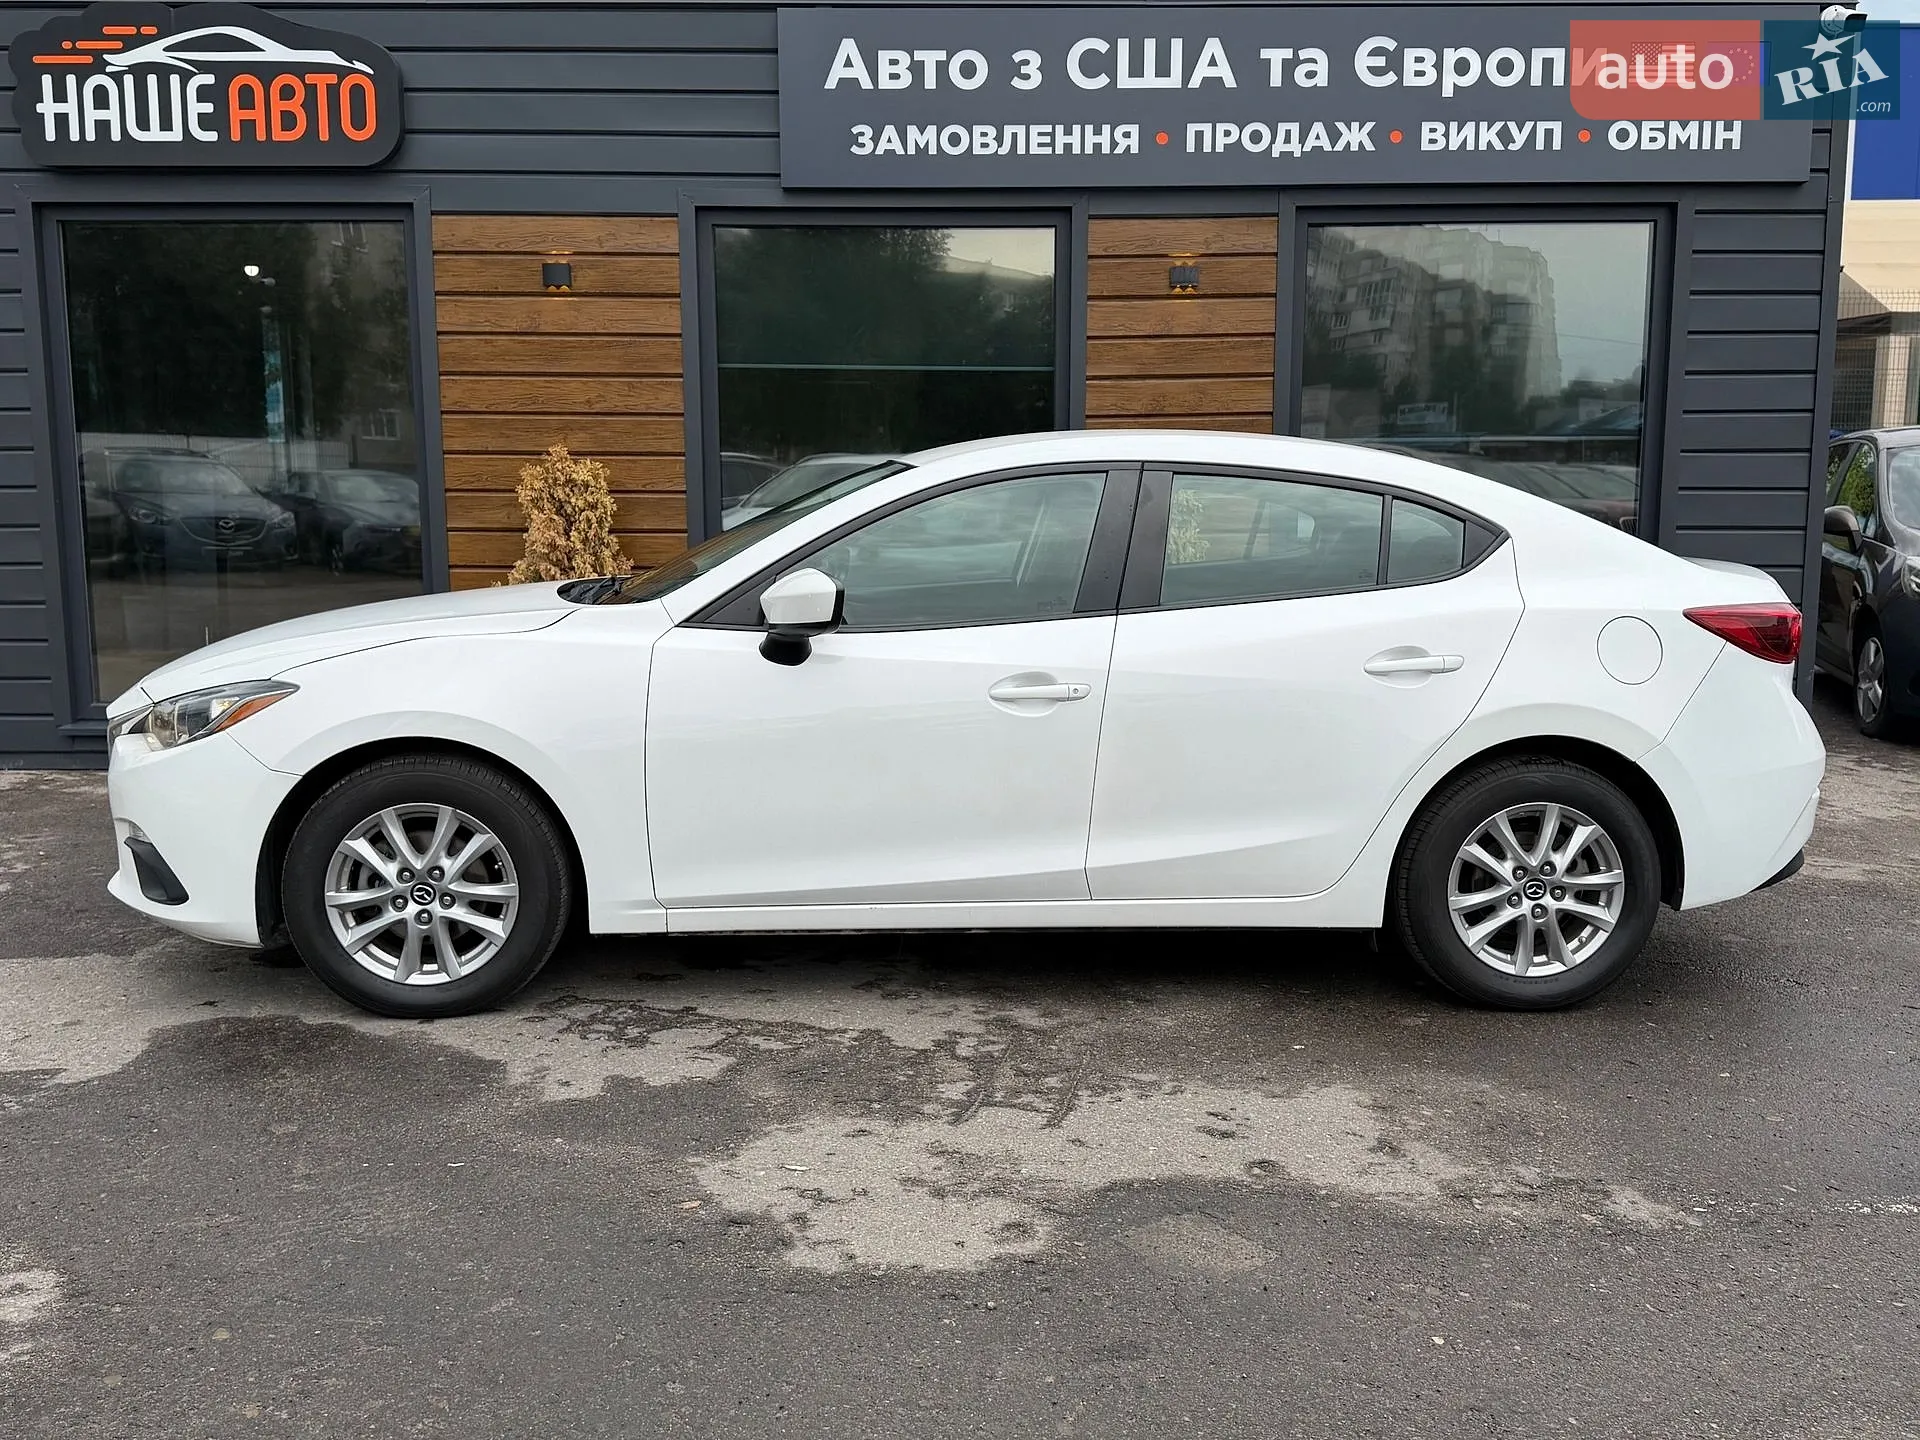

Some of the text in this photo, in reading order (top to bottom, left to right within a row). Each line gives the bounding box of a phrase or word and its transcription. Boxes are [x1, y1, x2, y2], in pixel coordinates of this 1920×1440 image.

[823, 35, 1608, 98] Авто з США та Європи
[35, 73, 377, 142] НАШЕ АВТО
[849, 119, 1742, 158] ЗАМОВЛЕННЯ ПРОДАЖ ВИКУП ОБМІН
